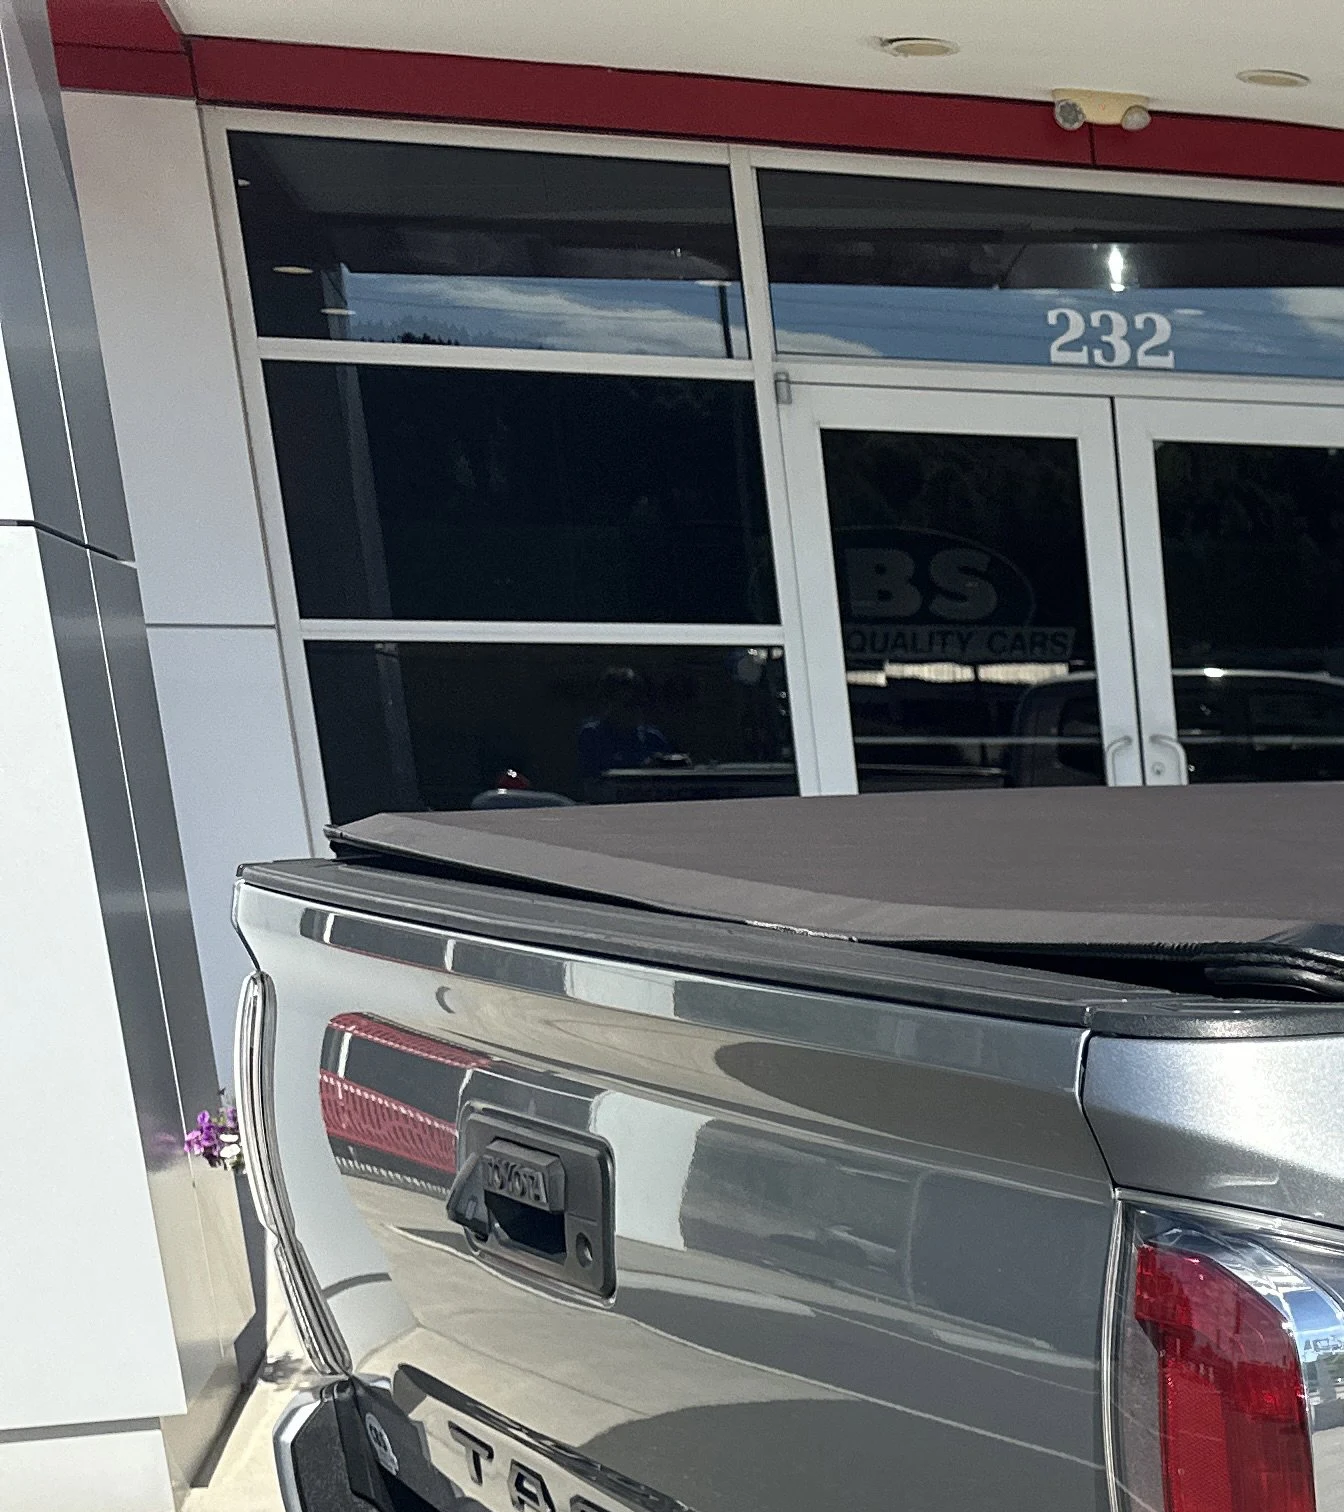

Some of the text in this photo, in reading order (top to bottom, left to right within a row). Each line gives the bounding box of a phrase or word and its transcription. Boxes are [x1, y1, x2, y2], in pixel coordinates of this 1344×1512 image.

[1047, 307, 1176, 369] 232
[845, 547, 998, 620] BS
[846, 629, 1071, 656] QUALITY CARS
[481, 1154, 549, 1206] TOYOTA
